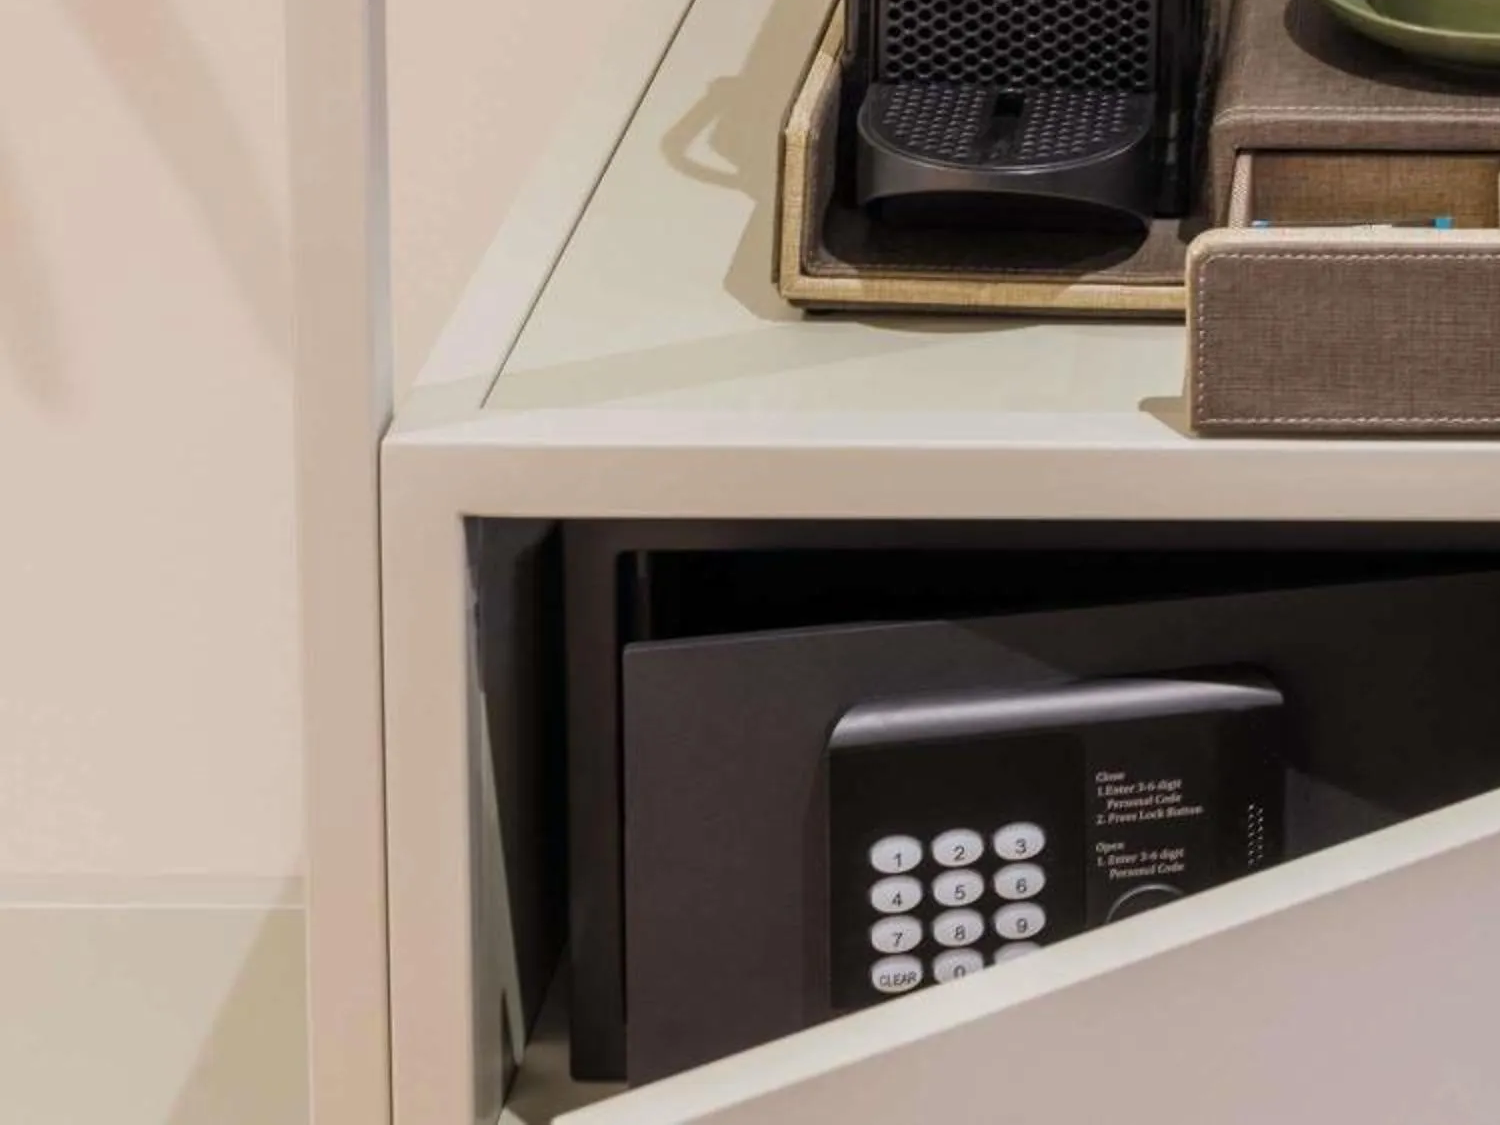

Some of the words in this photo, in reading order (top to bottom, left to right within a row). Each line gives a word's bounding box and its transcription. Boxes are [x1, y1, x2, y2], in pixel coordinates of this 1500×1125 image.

[1157, 779, 1182, 791] digit
[1107, 795, 1153, 809] Personal
[1155, 793, 1182, 804] Code
[1108, 812, 1137, 824] Press
[1138, 809, 1164, 820] Lock
[1166, 805, 1203, 817] Button
[893, 853, 902, 868] 1
[953, 845, 965, 861] 2
[1016, 838, 1026, 855] 3
[1096, 842, 1124, 854] Open
[1107, 854, 1138, 866] Enter
[1159, 848, 1184, 861] digit
[1158, 862, 1184, 874] Code
[892, 892, 903, 907] 4
[954, 885, 965, 901] 5
[1016, 878, 1027, 894] 6
[893, 932, 903, 947] 7
[954, 925, 965, 941] 8
[1016, 918, 1027, 934] 9
[879, 971, 918, 988] CLEAR
